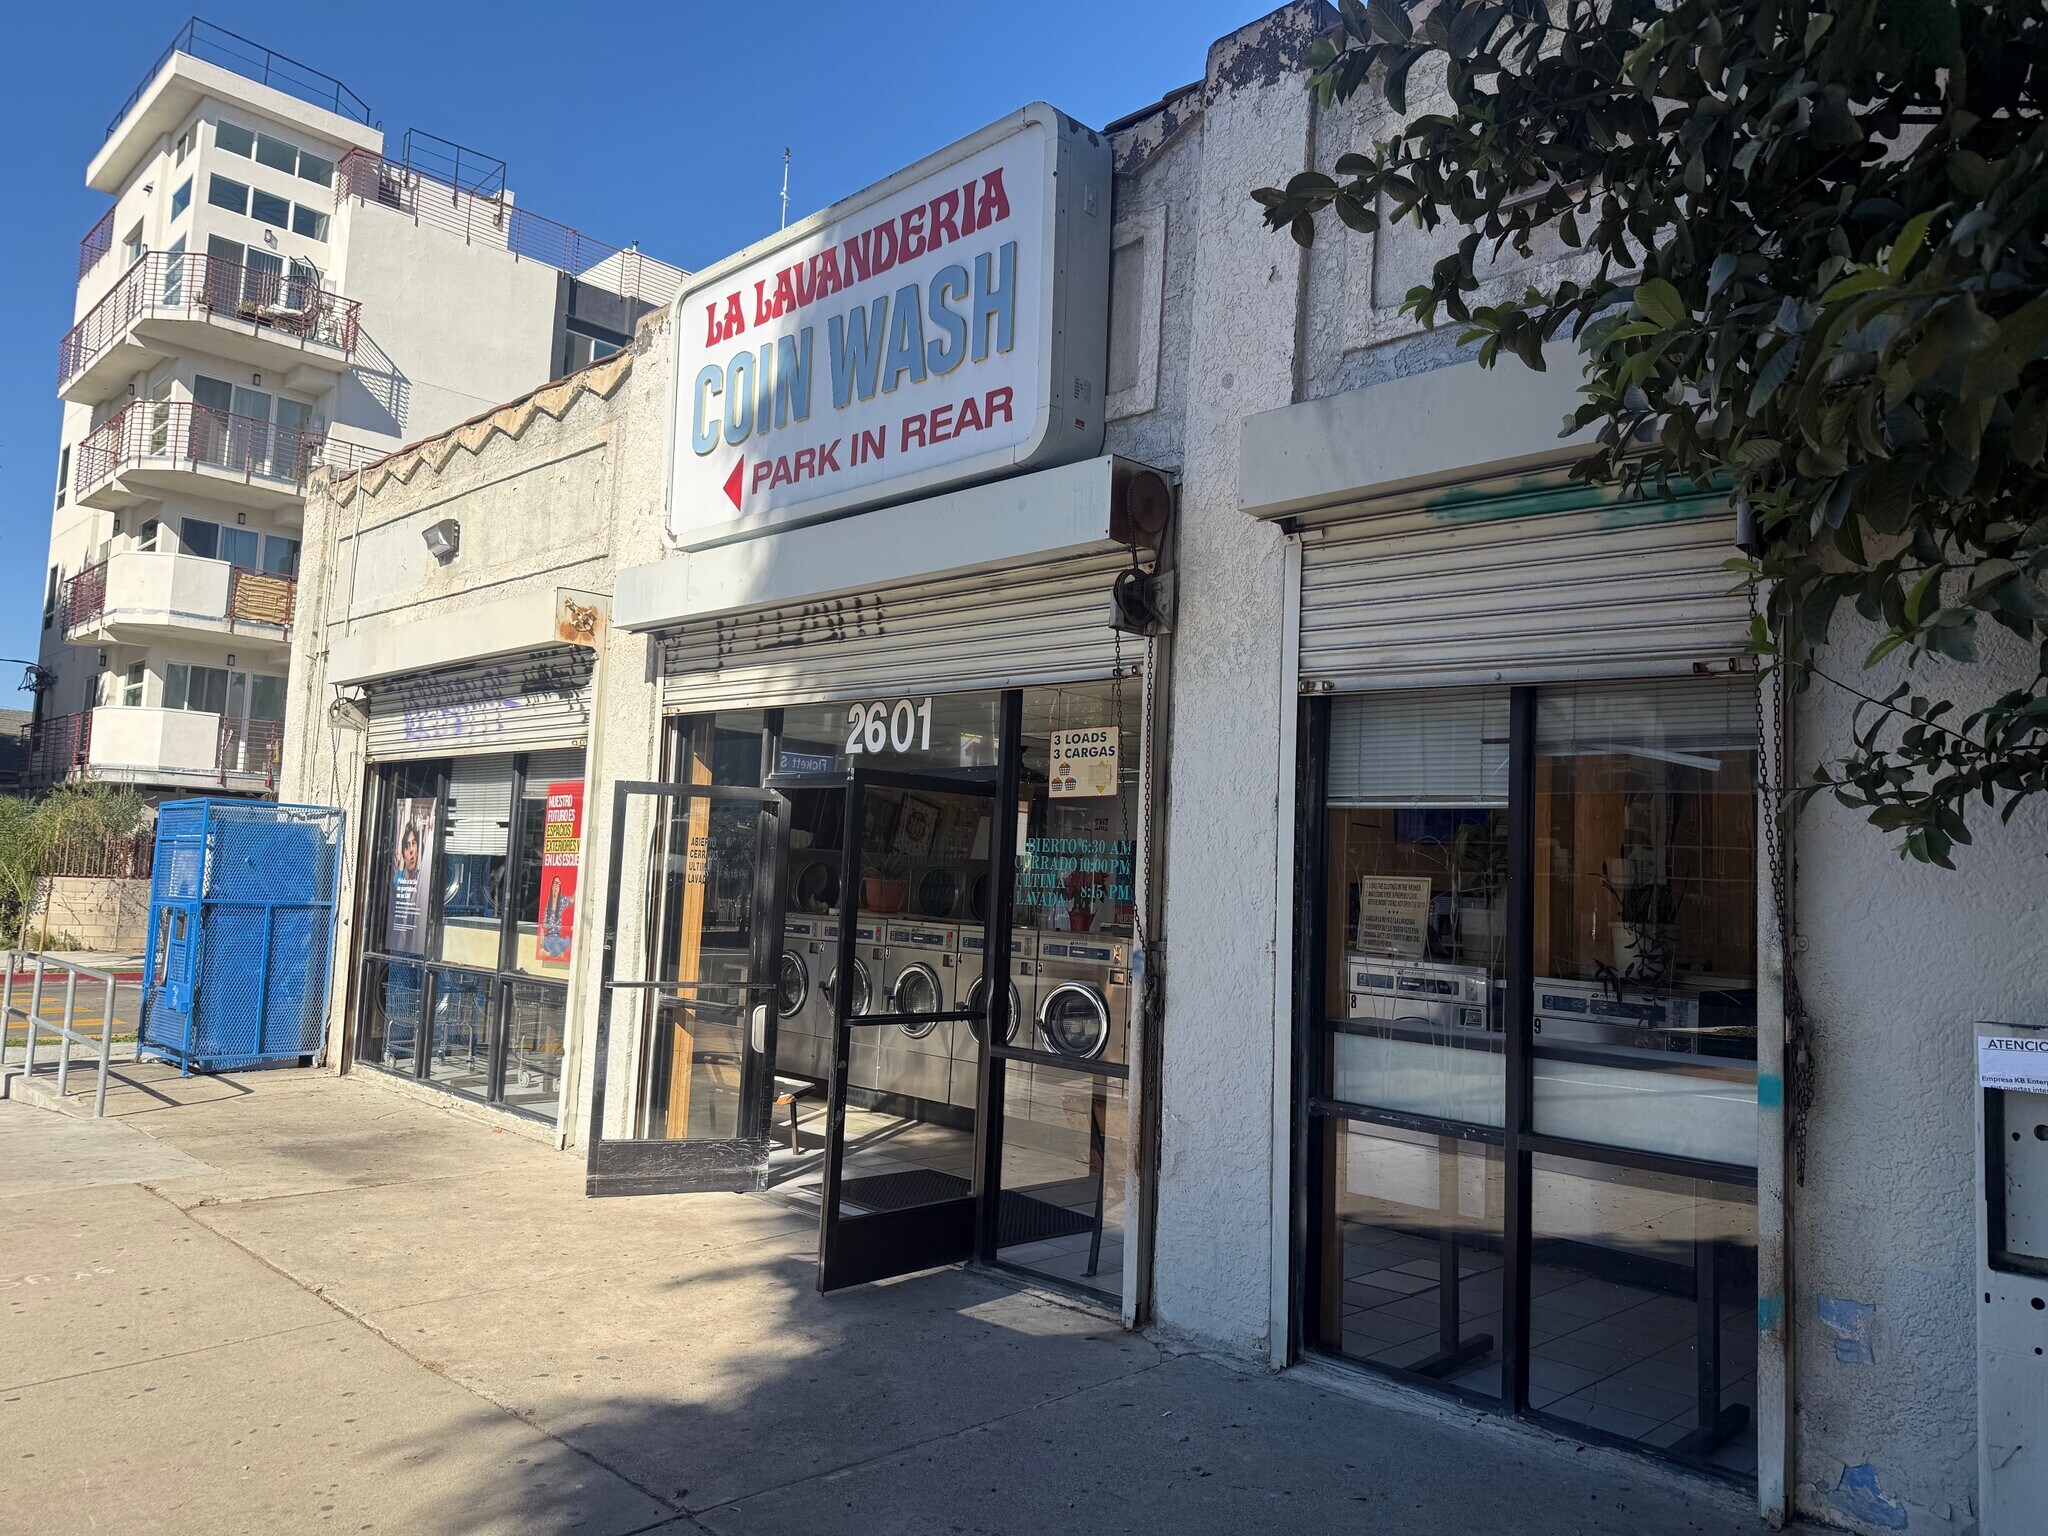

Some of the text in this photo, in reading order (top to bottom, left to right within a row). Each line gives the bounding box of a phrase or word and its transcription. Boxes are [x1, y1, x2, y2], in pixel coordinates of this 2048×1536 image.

[705, 166, 1010, 349] LA LAVANDERIA
[691, 240, 1017, 457] COIN WASH
[751, 438, 841, 496] PARK
[850, 424, 887, 467] IN
[900, 385, 1014, 454] REAR
[845, 697, 933, 755] 2601
[1054, 731, 1107, 745] 3 LOADS
[1053, 745, 1116, 759] 3 CARGAS
[549, 795, 573, 807] NUESTRO
[547, 809, 576, 822] FUTURO ES
[547, 824, 571, 837] ESPACIOS
[546, 839, 576, 852] EXTERIORES
[1024, 837, 1132, 855] BIERTO 6:30 AM
[545, 853, 552, 866] EN
[553, 853, 562, 865] LAS
[1079, 857, 1108, 873] 10:00
[1110, 859, 1131, 875] PM
[1015, 872, 1066, 889] ULTIMA
[1015, 889, 1067, 907] LAVADA
[1080, 884, 1131, 900] 8:15 PM
[1350, 994, 1357, 1009] 8
[1533, 1017, 1542, 1035] 9
[1981, 1075, 2013, 1084] Empresa
